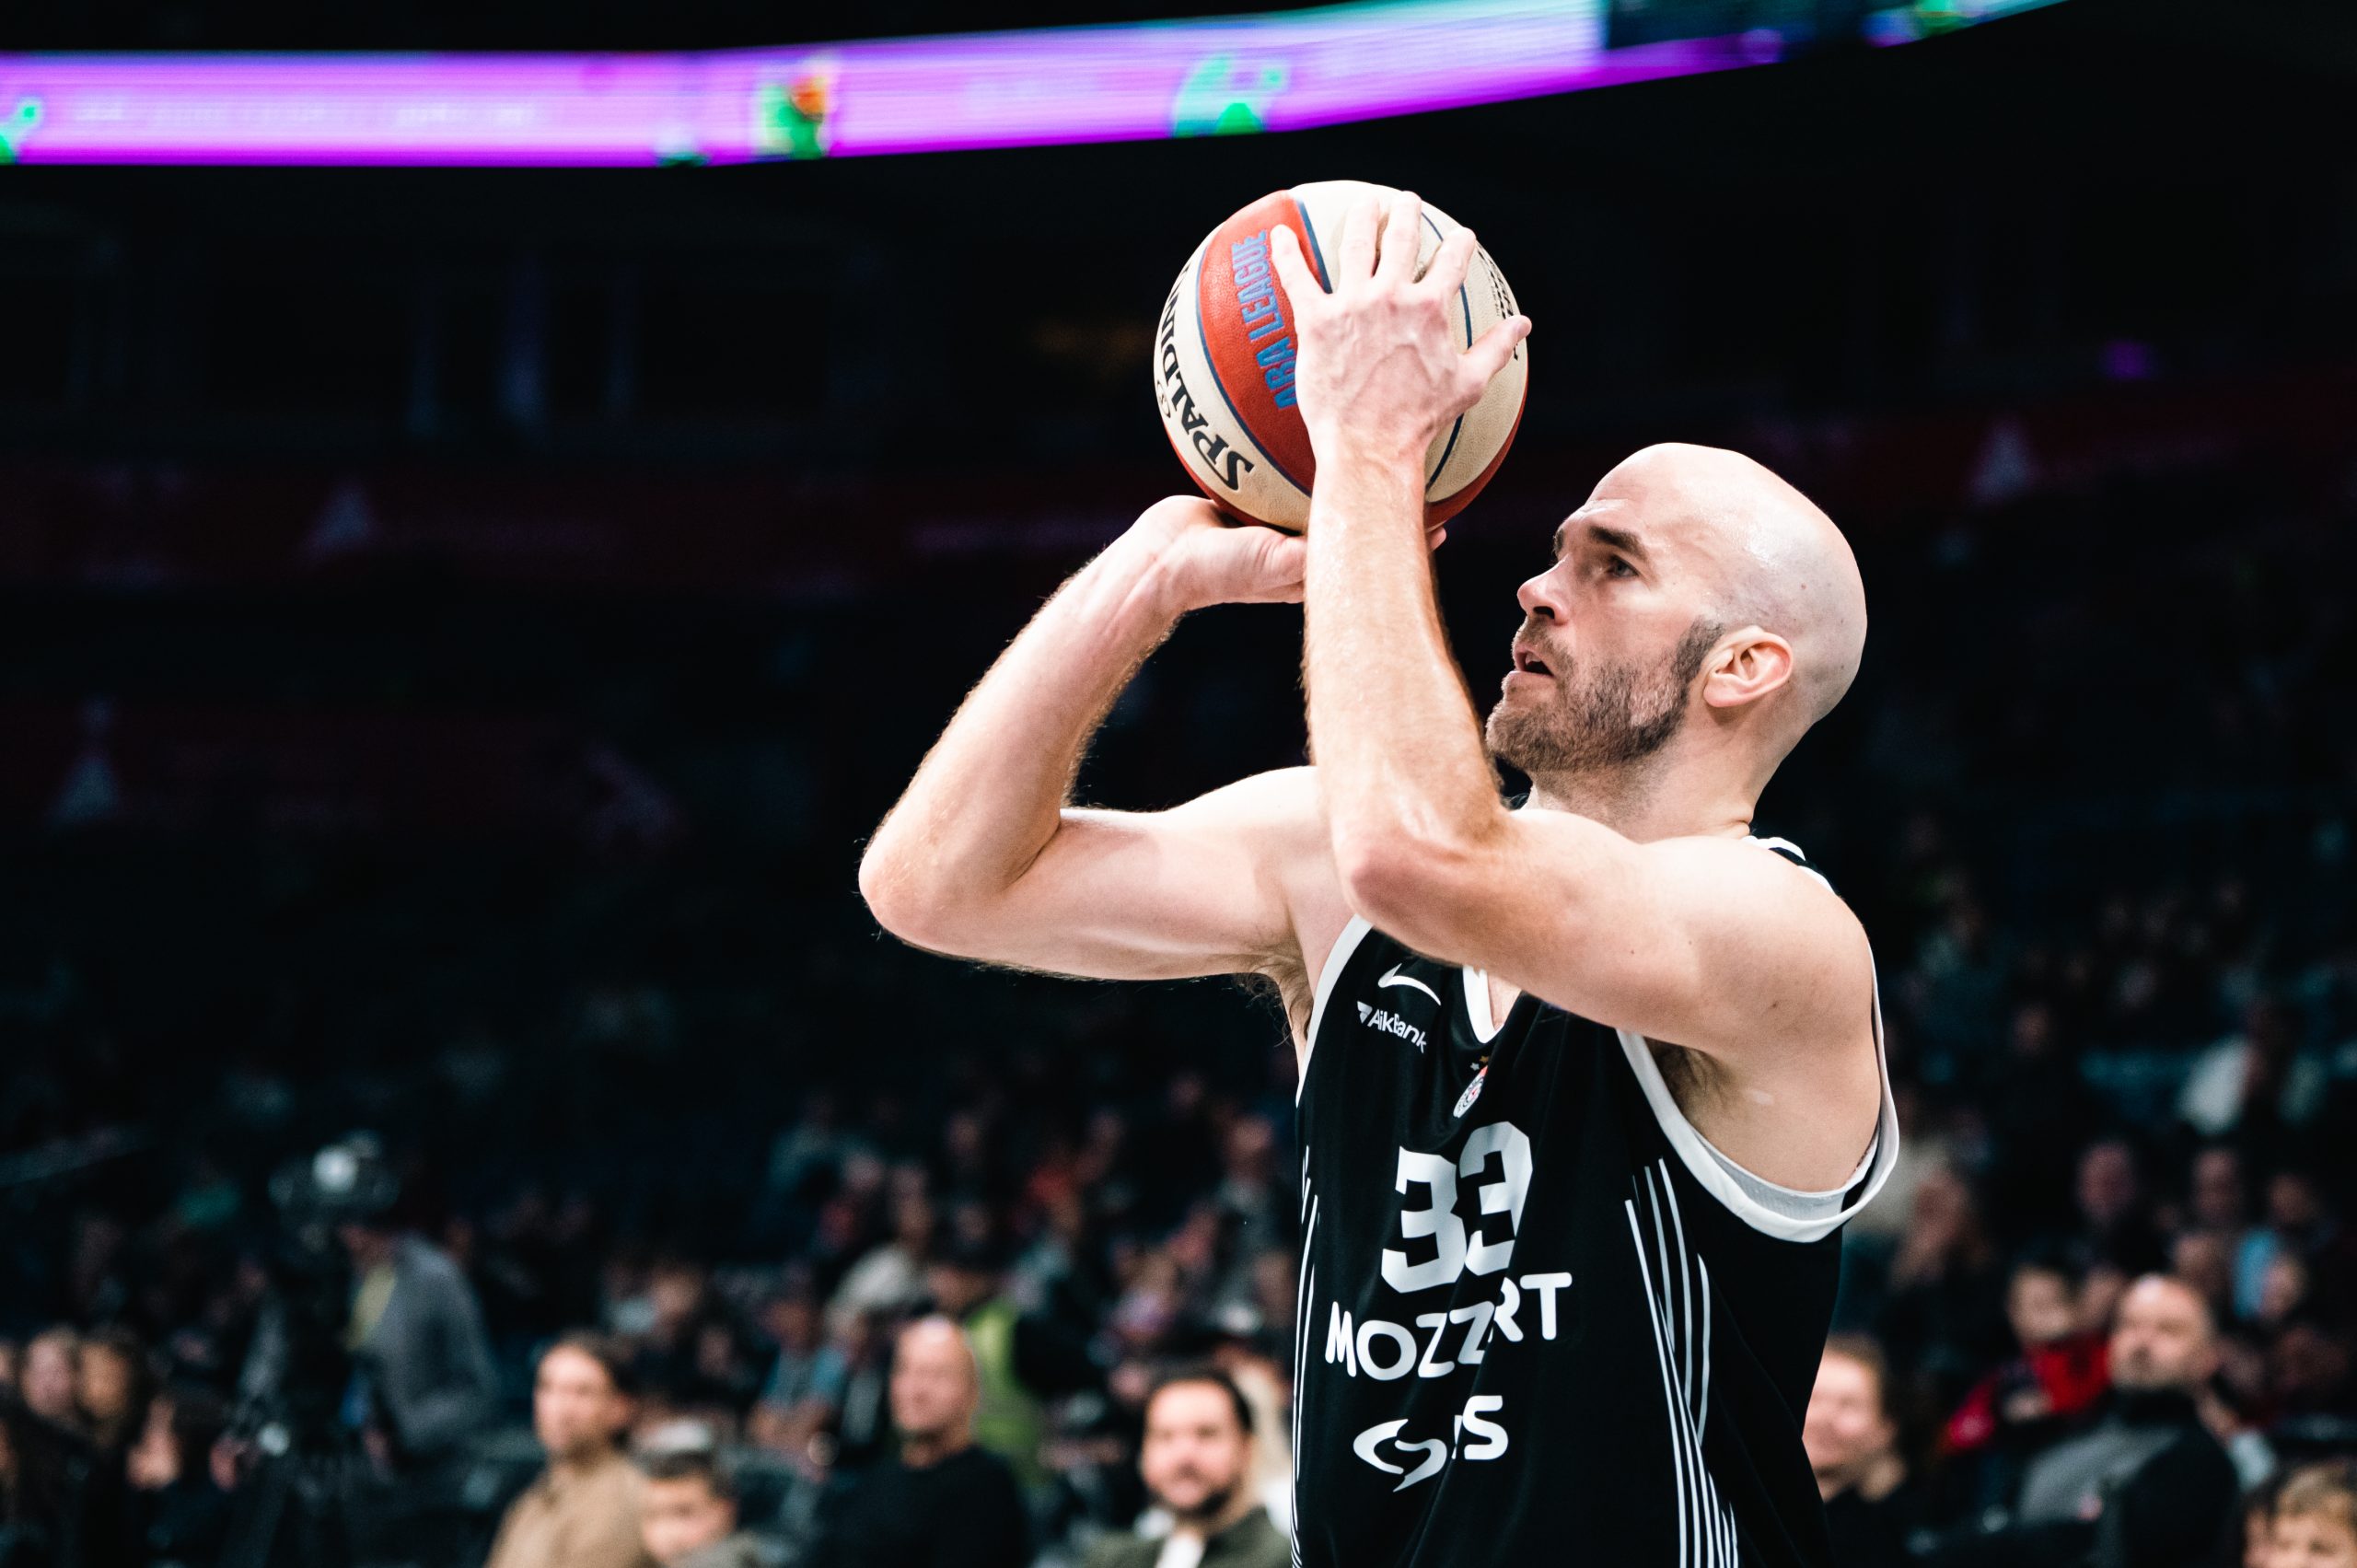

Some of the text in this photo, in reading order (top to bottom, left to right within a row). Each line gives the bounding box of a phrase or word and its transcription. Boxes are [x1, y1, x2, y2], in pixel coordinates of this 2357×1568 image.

[1232, 229, 1284, 343] LEAGUE
[1381, 1121, 1534, 1294] 33
[1325, 1272, 1573, 1381] MOZZRT
